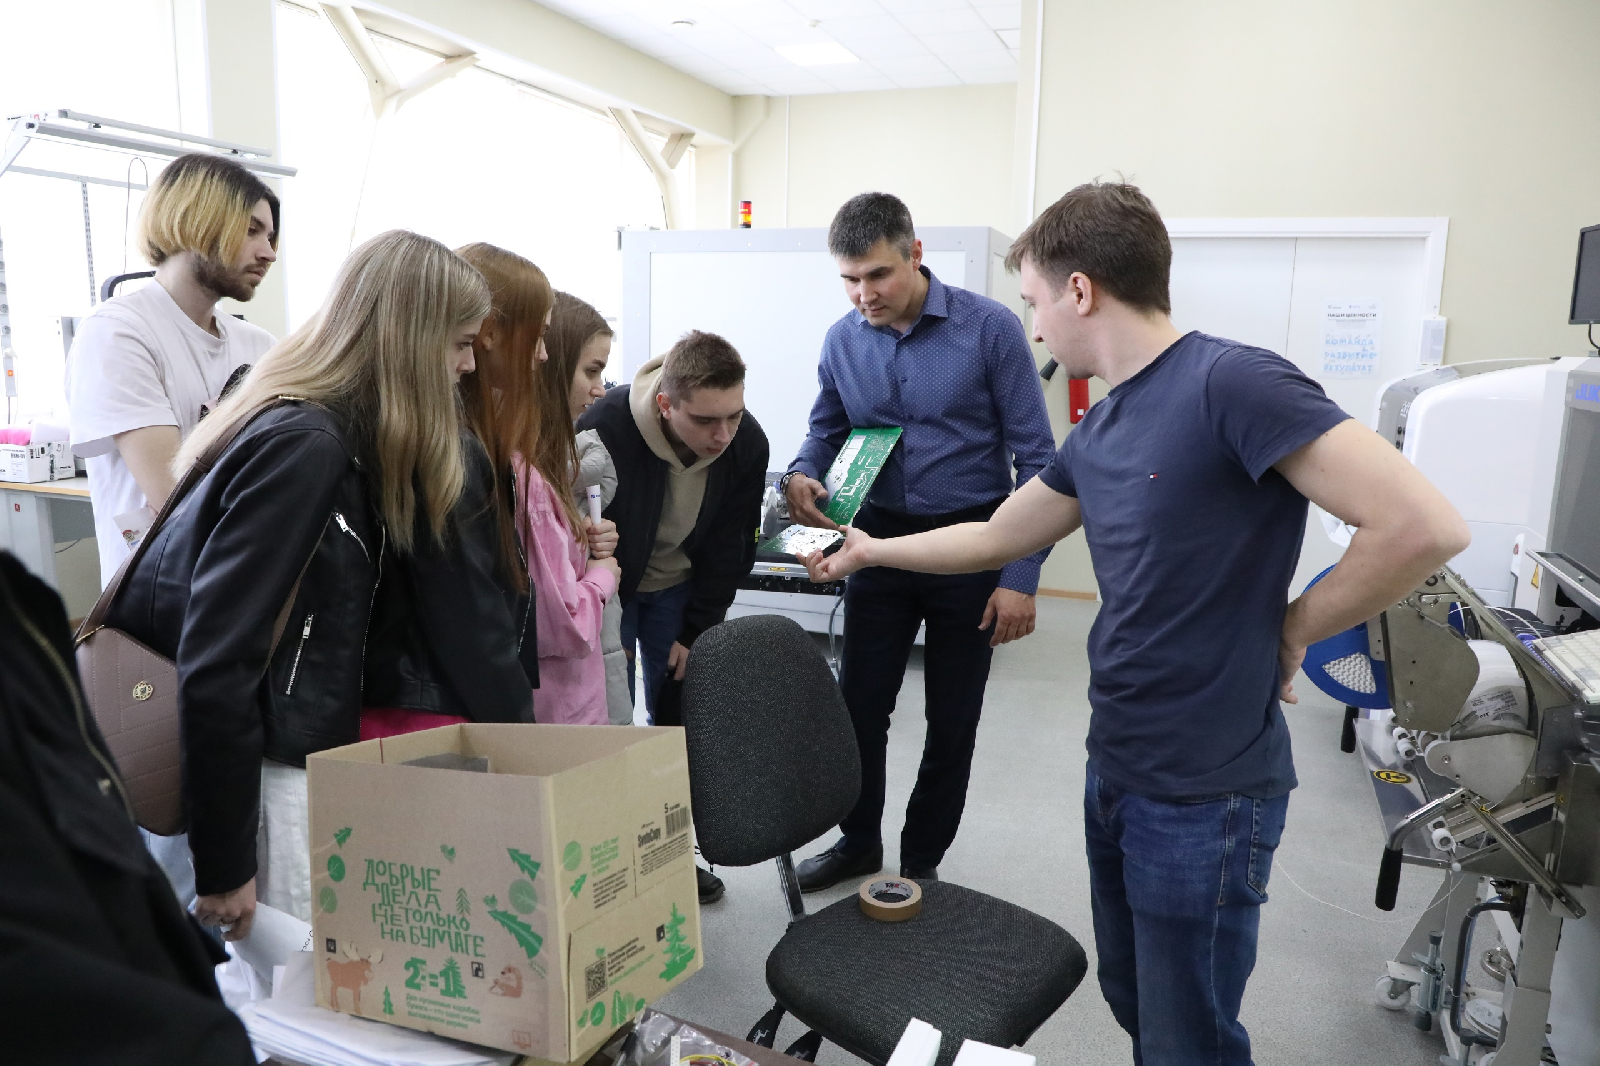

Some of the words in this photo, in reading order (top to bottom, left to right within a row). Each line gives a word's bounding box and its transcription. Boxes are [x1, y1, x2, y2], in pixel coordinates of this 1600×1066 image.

[1325, 338, 1374, 346] КОМАНДА
[363, 859, 442, 896] ДОБРЫЕ
[378, 882, 442, 913] ДЕЛА
[371, 903, 403, 928] НЕ
[398, 906, 471, 932] ТОЛЬКО
[380, 922, 406, 942] НА
[409, 925, 486, 958] БУМАГЕ
